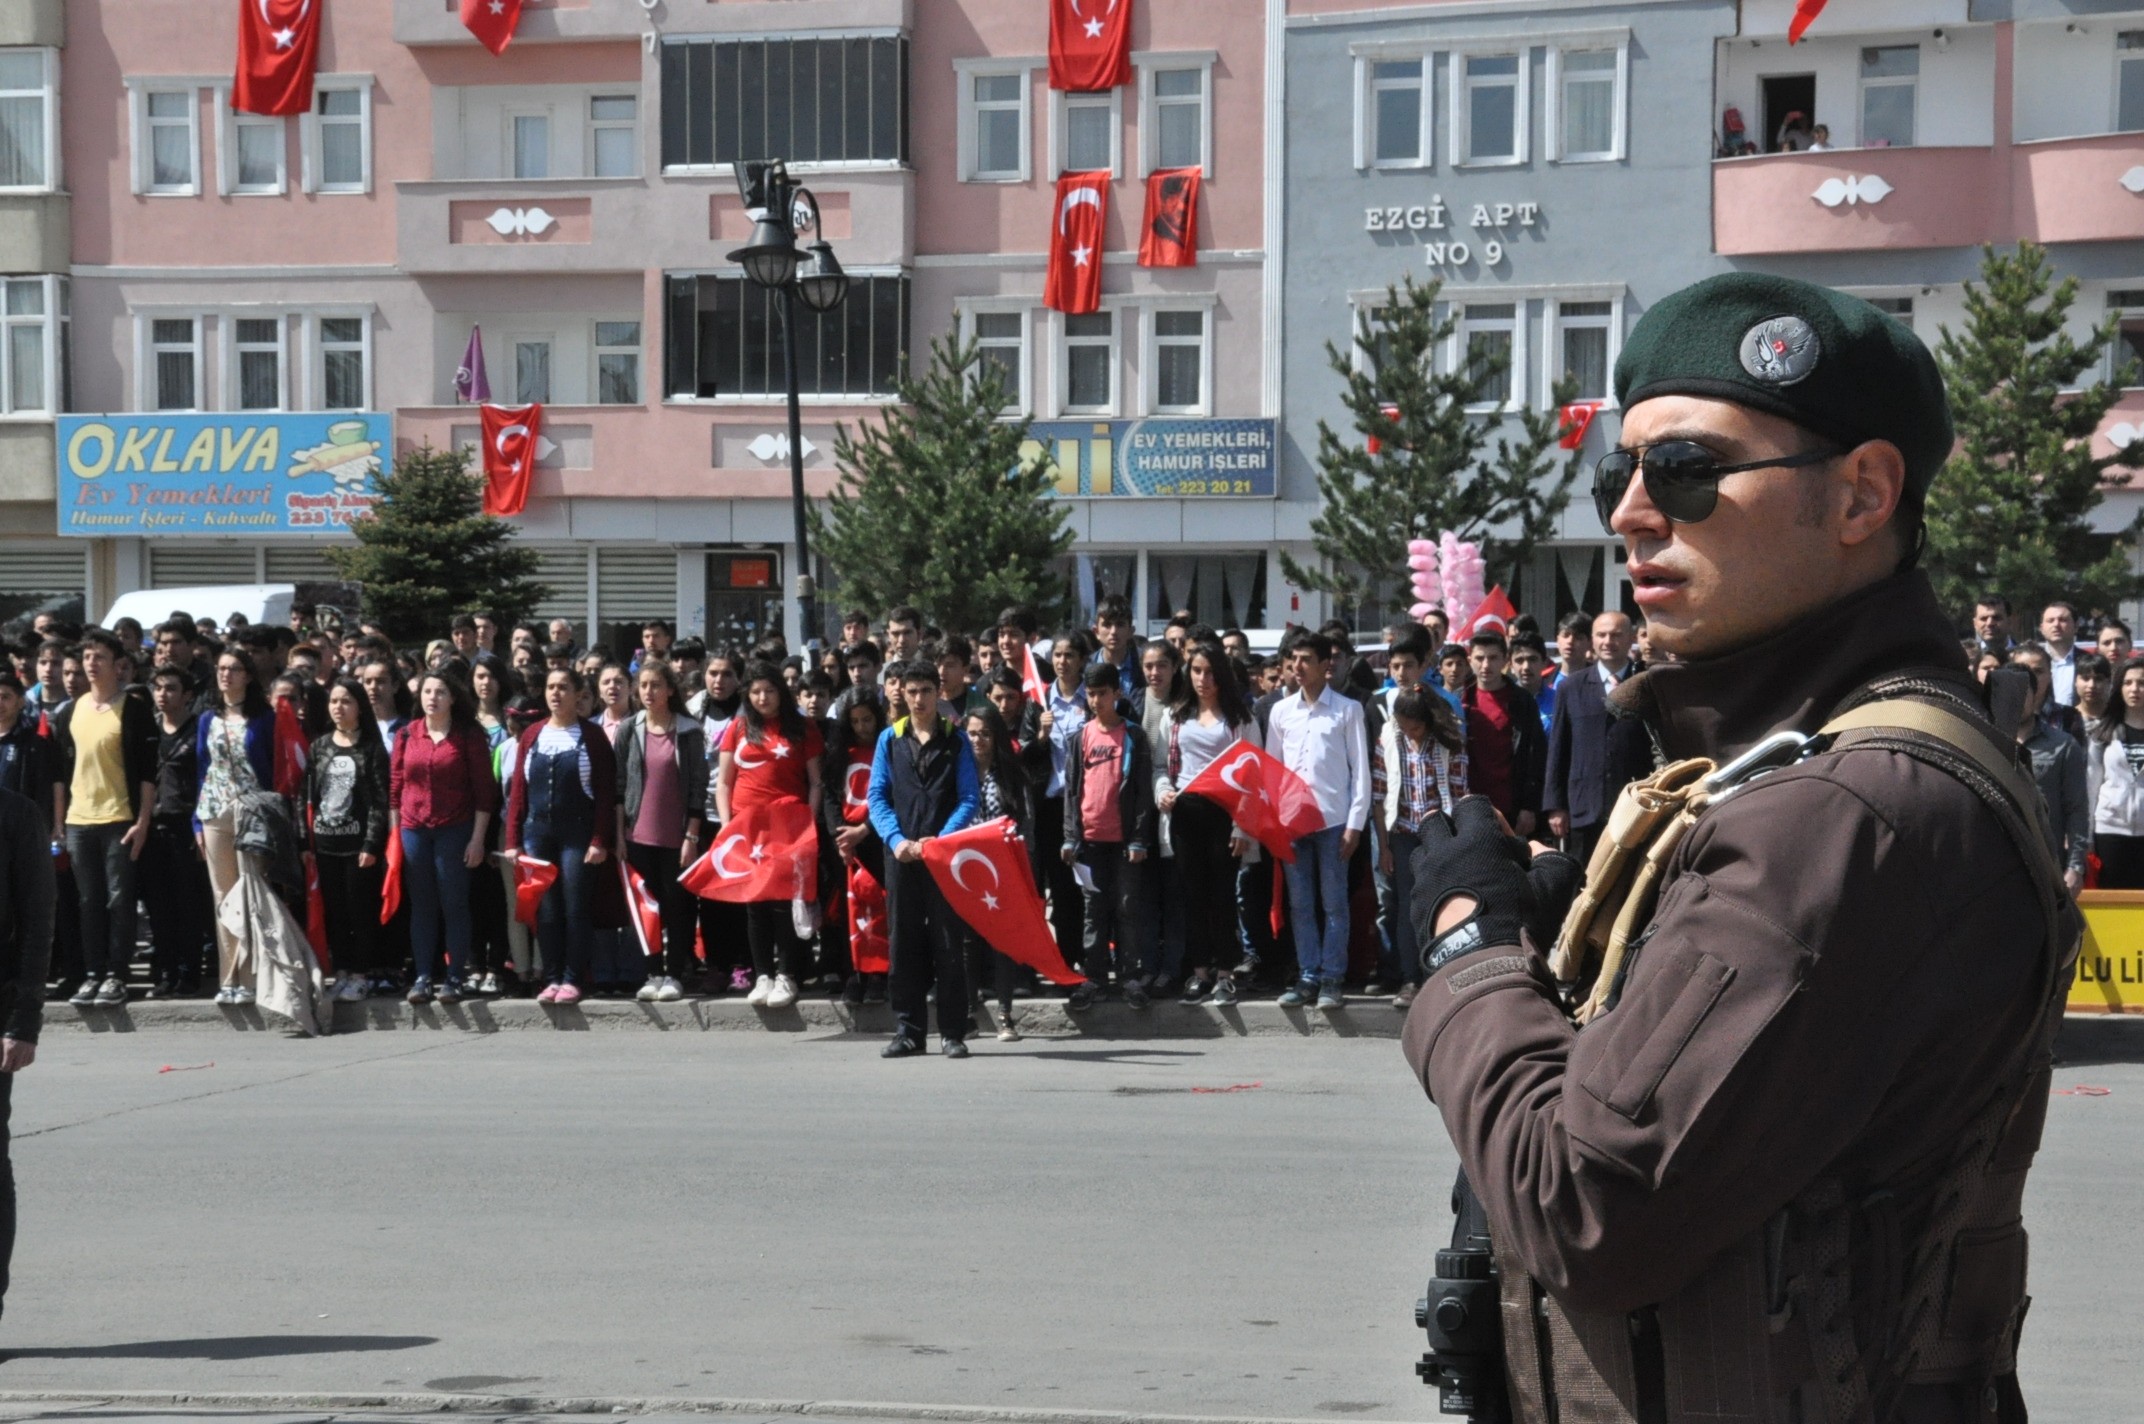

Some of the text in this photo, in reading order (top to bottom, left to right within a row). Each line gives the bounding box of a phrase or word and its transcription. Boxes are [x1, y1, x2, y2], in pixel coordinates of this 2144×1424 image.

[1365, 194, 1538, 230] EZGİ APT
[1424, 240, 1502, 266] NO 9
[1134, 428, 1271, 450] EV YEMEKLERİ,
[67, 423, 280, 480] OKLAVA
[1138, 450, 1267, 473] HAMUR İŞLERİ
[75, 482, 273, 506] Ev Yemekleri
[1155, 480, 1251, 494] Tel: 223 20 21
[70, 510, 134, 526] Hamur
[139, 507, 186, 528] İşleri
[203, 510, 278, 526] Kahvaltı
[1090, 745, 1119, 759] NIKE
[2079, 956, 2111, 983] LU
